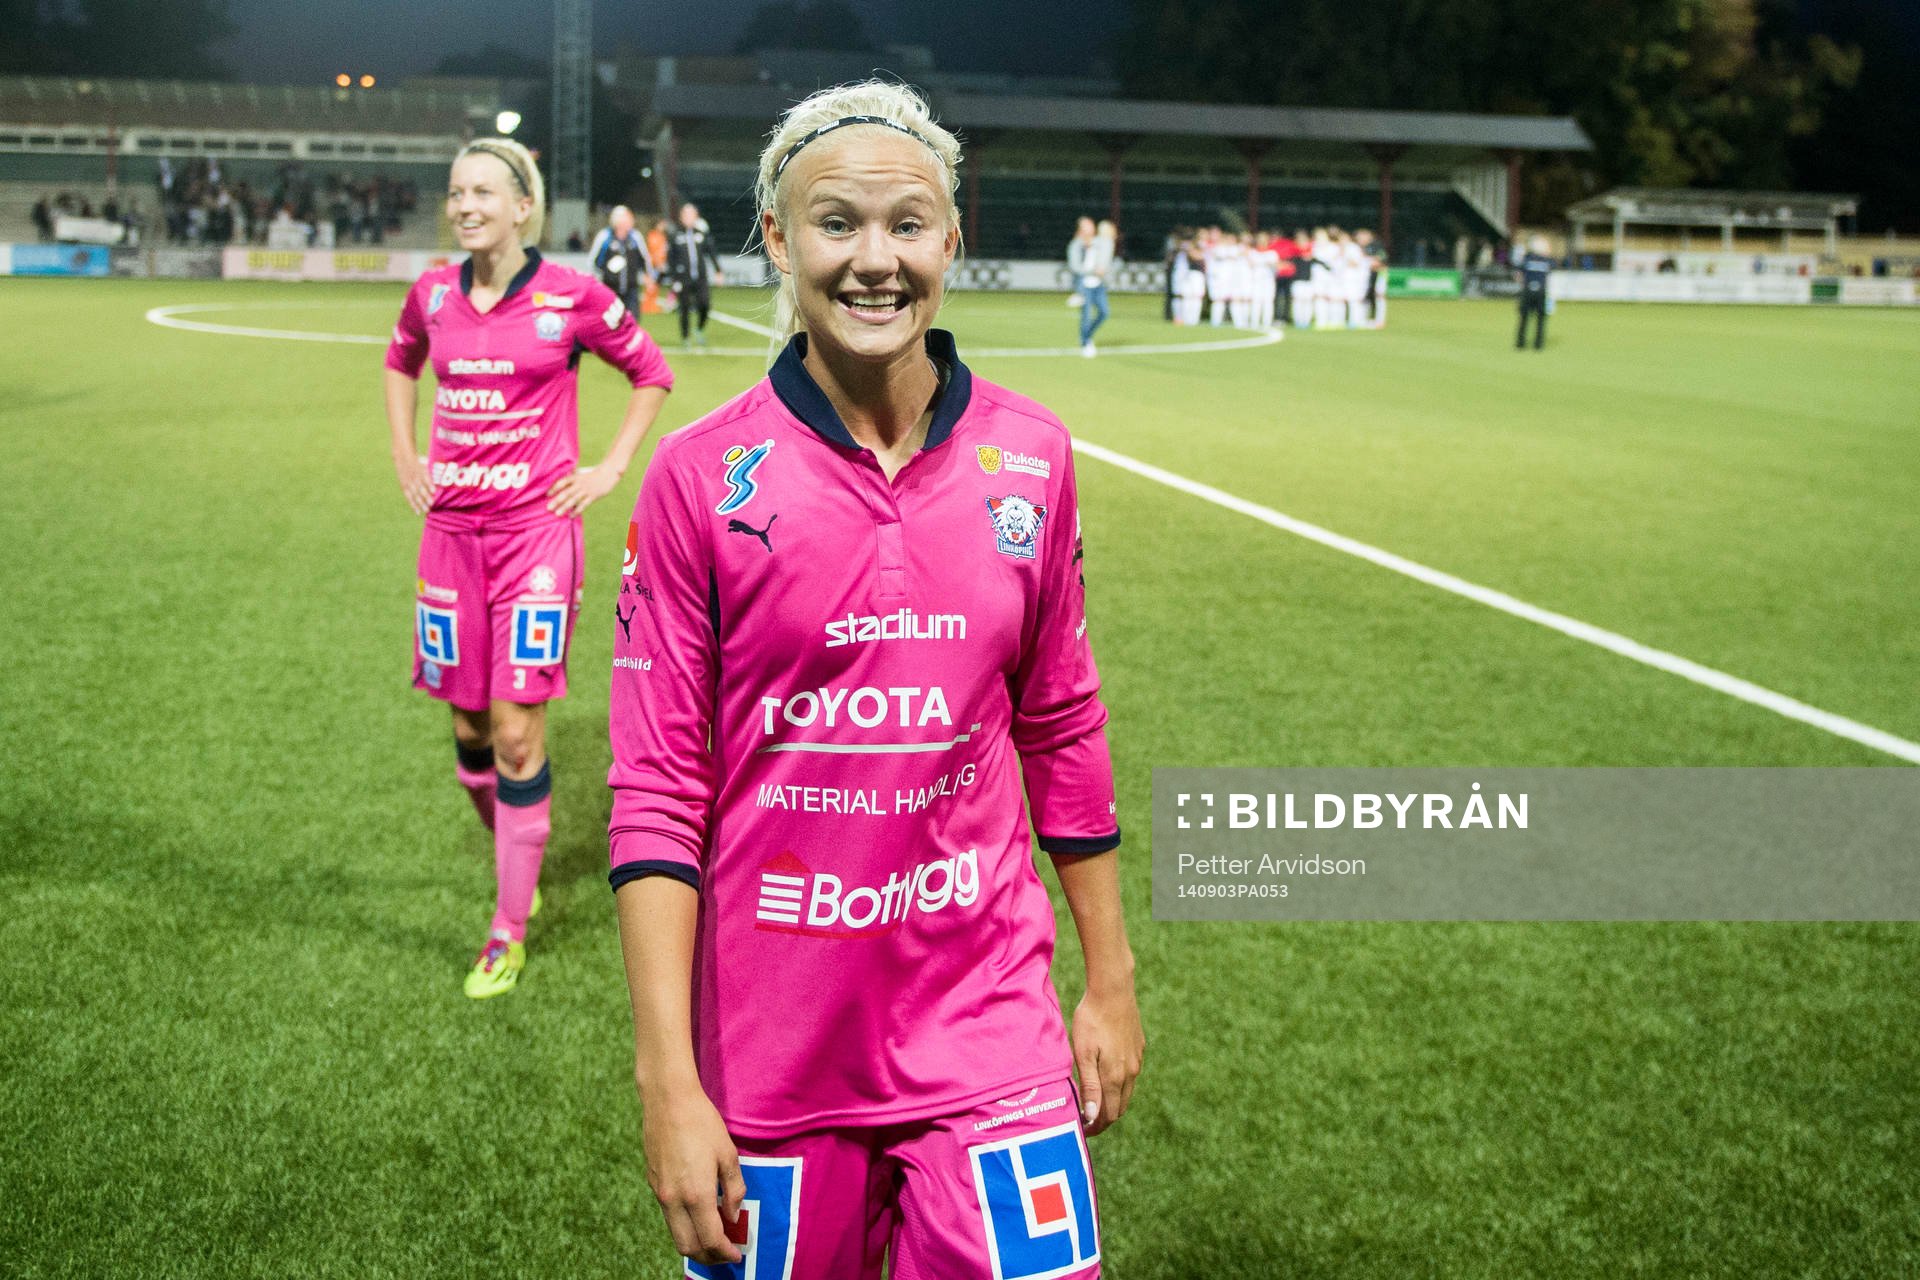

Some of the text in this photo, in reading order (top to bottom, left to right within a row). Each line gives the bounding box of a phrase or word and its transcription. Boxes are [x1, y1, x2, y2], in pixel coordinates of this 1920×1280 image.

[436, 388, 505, 410] YOTA
[1003, 451, 1050, 471] Dukaten
[825, 608, 966, 648] stadium
[513, 668, 526, 690] 3
[761, 686, 953, 735] TOYOTA
[756, 763, 976, 815] MATERIAL HANDLIG
[806, 849, 980, 929] Botrygg
[974, 1110, 1024, 1131] LINKÖPINGS
